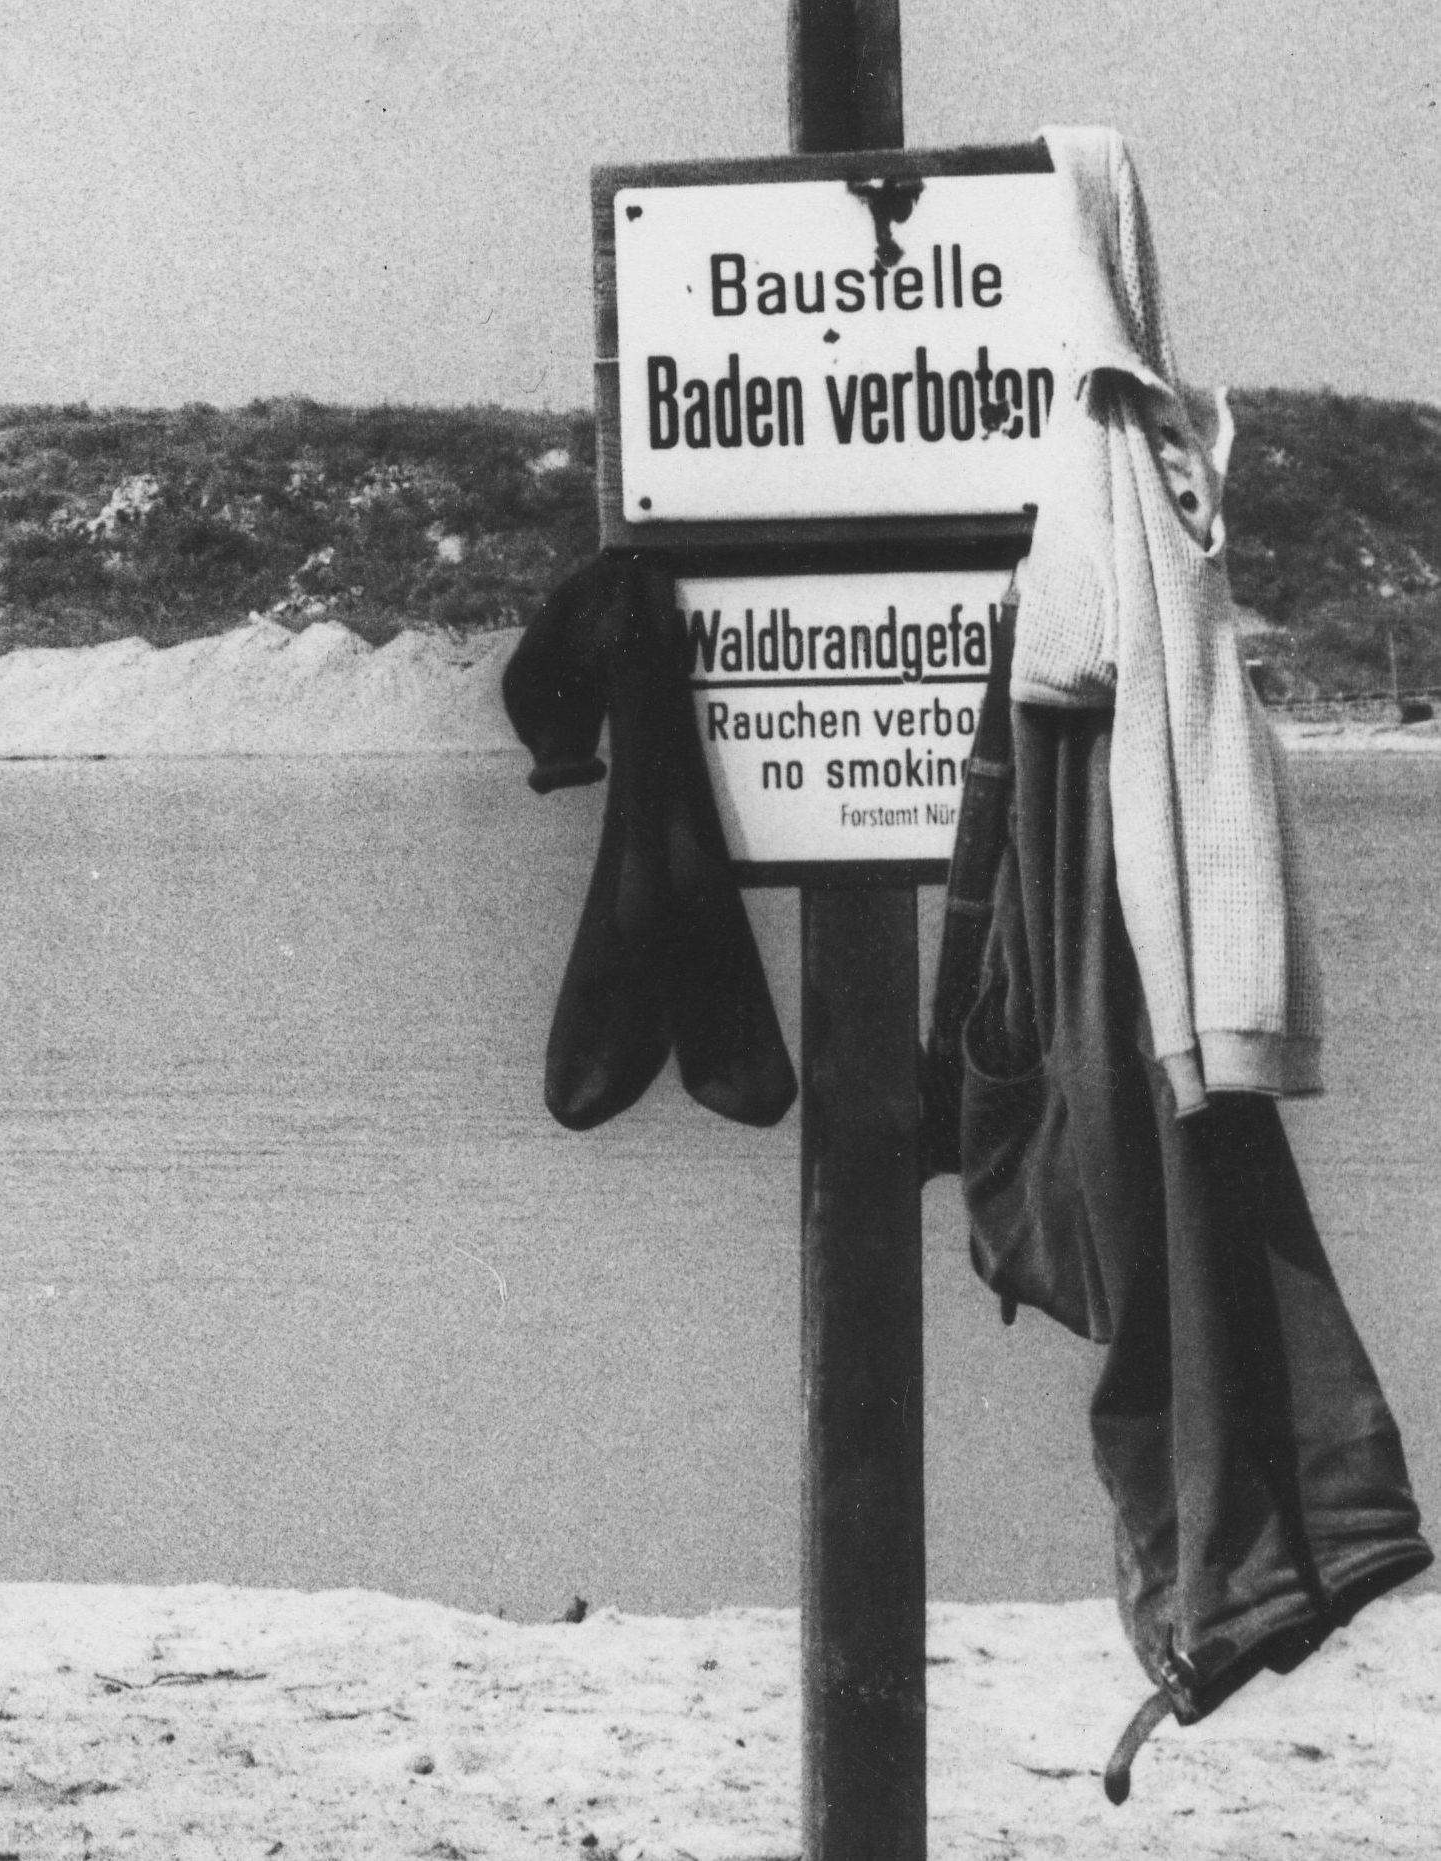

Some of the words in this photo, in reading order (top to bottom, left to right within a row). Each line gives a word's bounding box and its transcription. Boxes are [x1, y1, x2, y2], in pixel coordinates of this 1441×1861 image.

[710, 243, 1004, 317] Baustelle
[646, 352, 805, 450] Baden
[825, 345, 1055, 446] verboten
[708, 699, 861, 742] Rauchen
[873, 696, 976, 737] verbo
[762, 759, 804, 790] no
[826, 747, 969, 790] smokin
[840, 803, 919, 827] Forstamt
